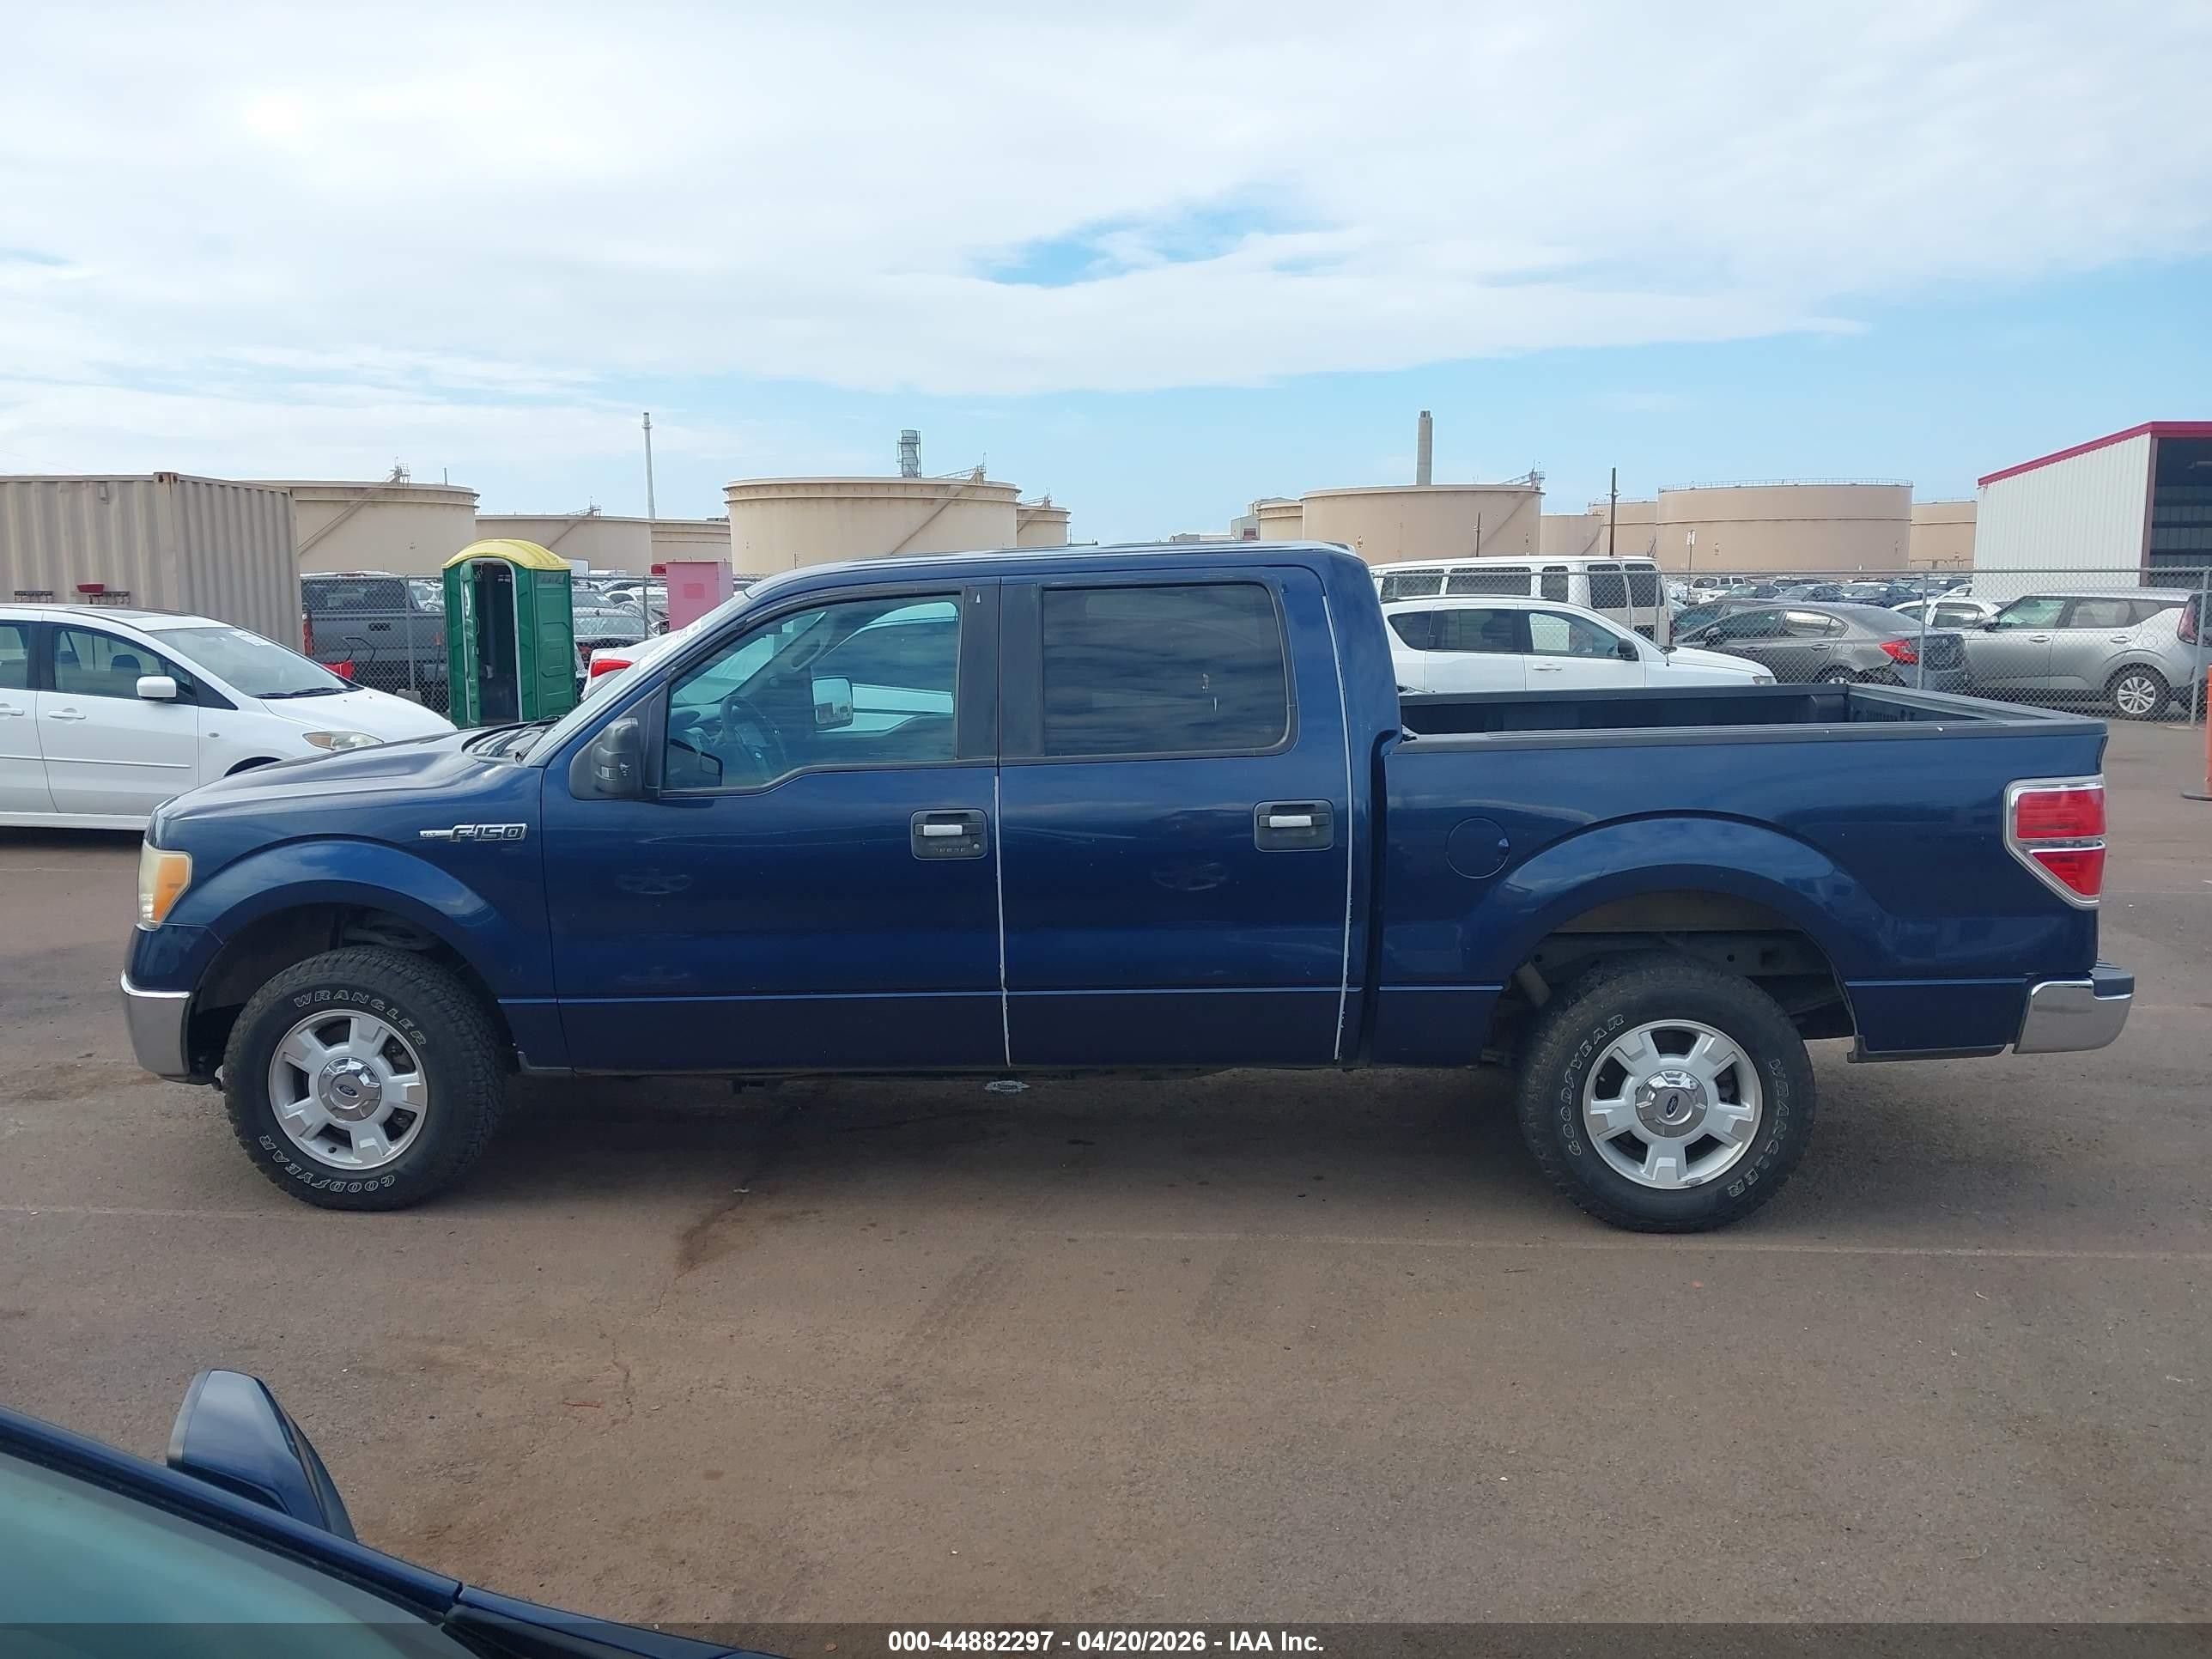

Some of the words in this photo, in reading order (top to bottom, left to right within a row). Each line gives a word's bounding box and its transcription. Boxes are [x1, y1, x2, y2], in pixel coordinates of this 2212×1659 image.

[452, 823, 528, 842] F-150
[294, 989, 427, 1046] WRANGLER
[1559, 1013, 1625, 1157] GOODYEAR
[1727, 1058, 1790, 1198] WRANGLER
[258, 1134, 395, 1194] GOODYEAR
